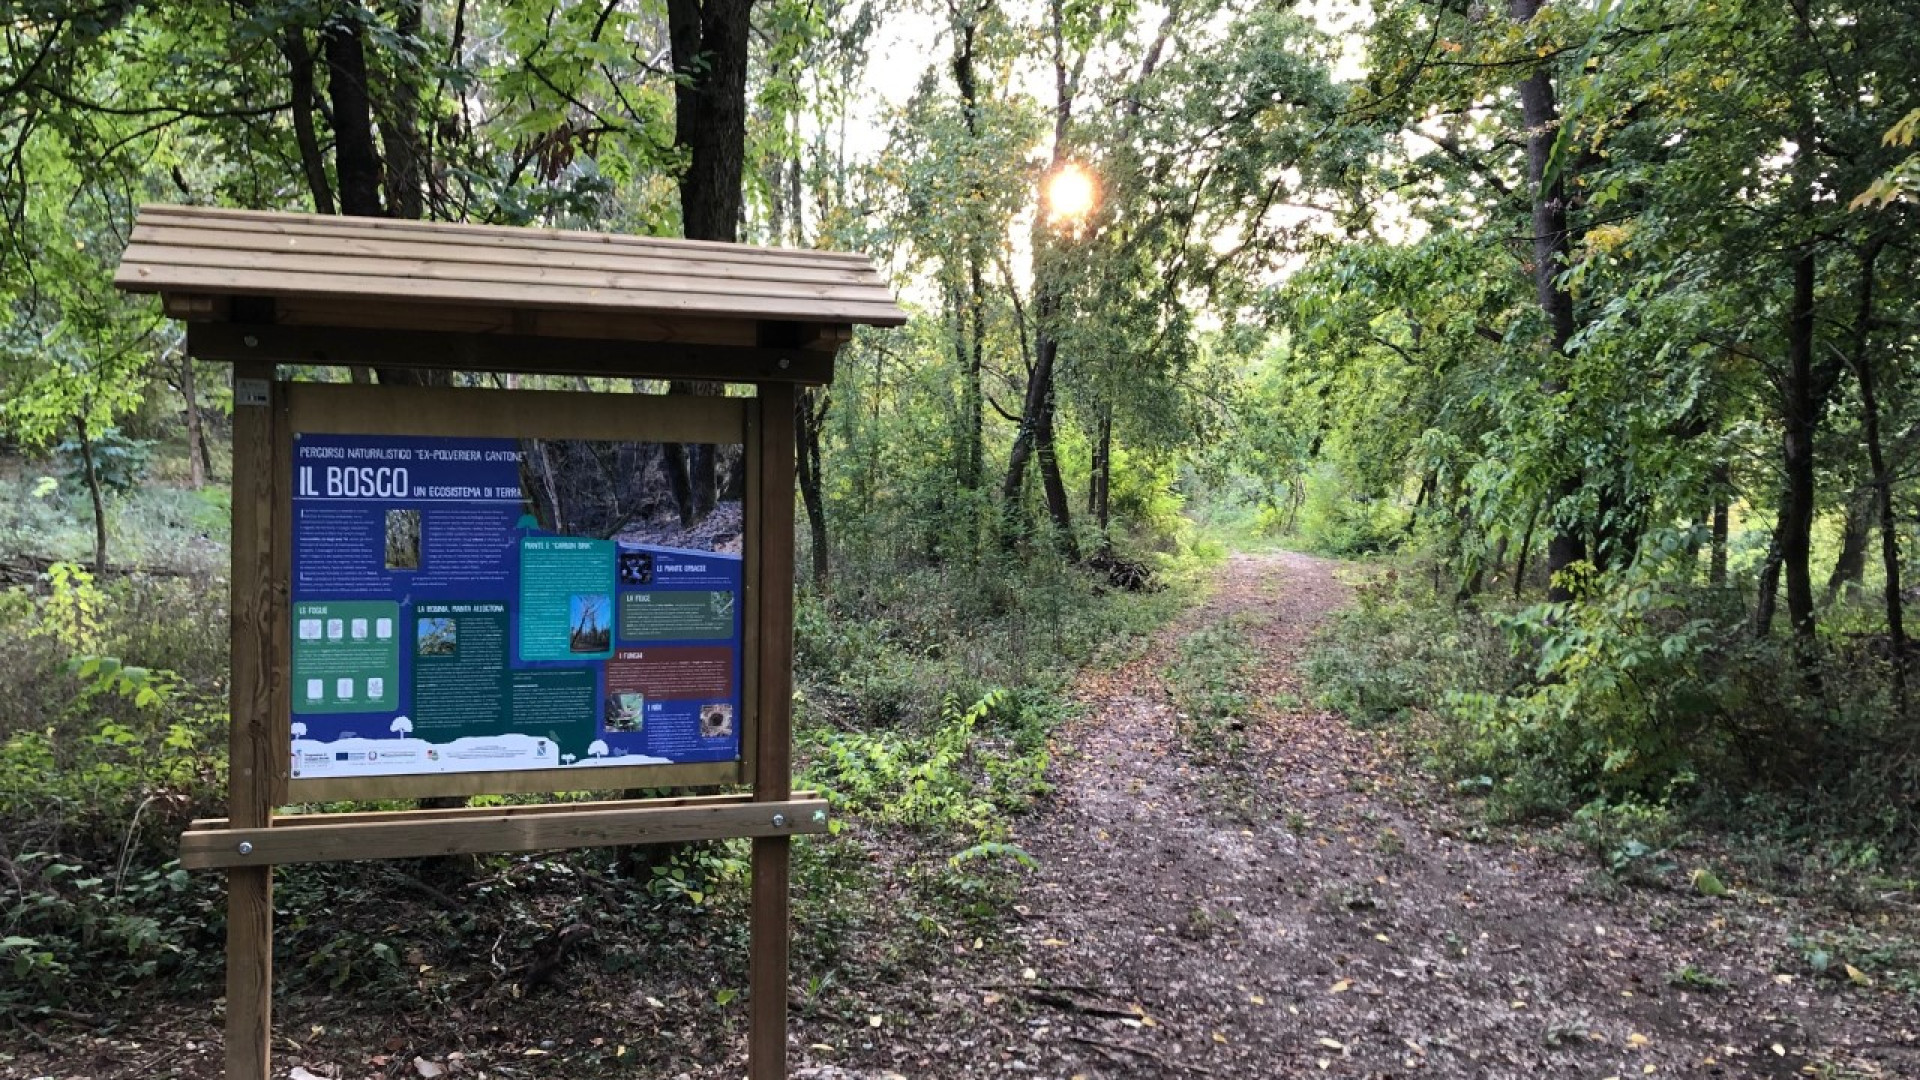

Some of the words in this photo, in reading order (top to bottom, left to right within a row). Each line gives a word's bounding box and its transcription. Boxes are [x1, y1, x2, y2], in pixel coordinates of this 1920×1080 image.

[300, 446, 344, 459] PERCORSO
[347, 448, 412, 460] NATURALISTICO
[299, 466, 319, 496] IL
[327, 466, 408, 497] BOSCO
[413, 486, 427, 497] UN
[428, 486, 481, 498] ECOSISTEMA
[484, 487, 493, 497] DI
[495, 487, 522, 498] TERRA
